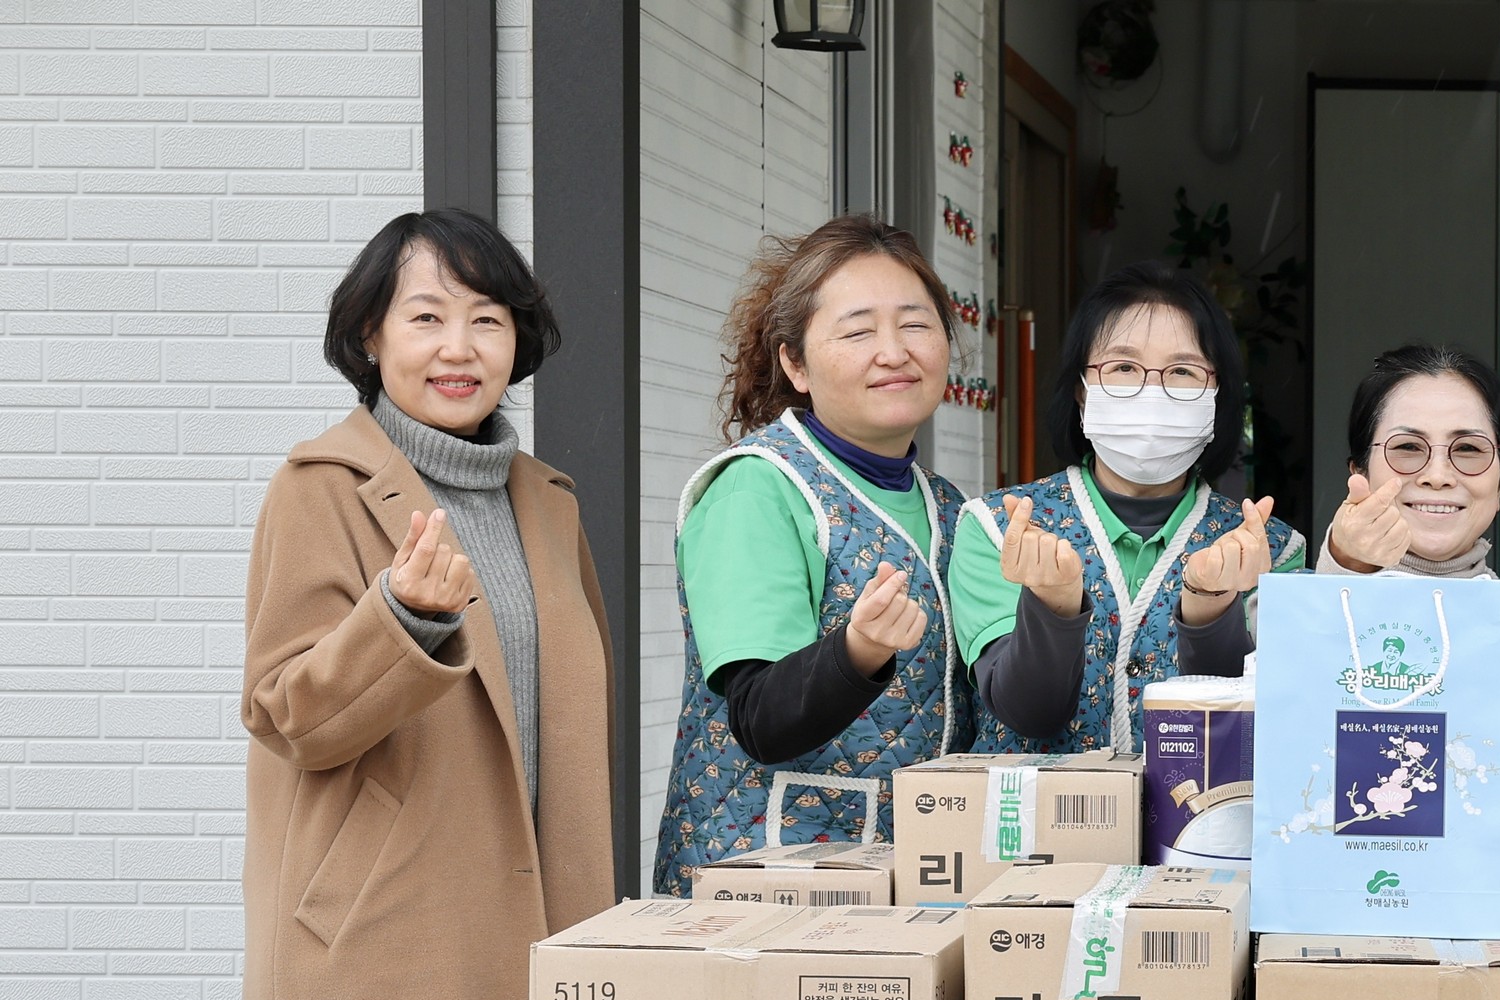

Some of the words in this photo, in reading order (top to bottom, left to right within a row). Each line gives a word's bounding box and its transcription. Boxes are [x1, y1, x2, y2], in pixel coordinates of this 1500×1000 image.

[1416, 699, 1440, 710] Family
[1160, 742, 1195, 753] 0121102
[1176, 784, 1194, 798] New
[1206, 785, 1248, 802] Premium
[938, 796, 967, 813] 애경
[1345, 839, 1428, 852] www.maesil.co.kr
[920, 852, 963, 894] 리
[1364, 898, 1409, 909] 청매실농원
[1015, 933, 1046, 950] 애경
[817, 981, 839, 994] 커피
[842, 982, 853, 994] 한
[857, 982, 878, 994] 잔의
